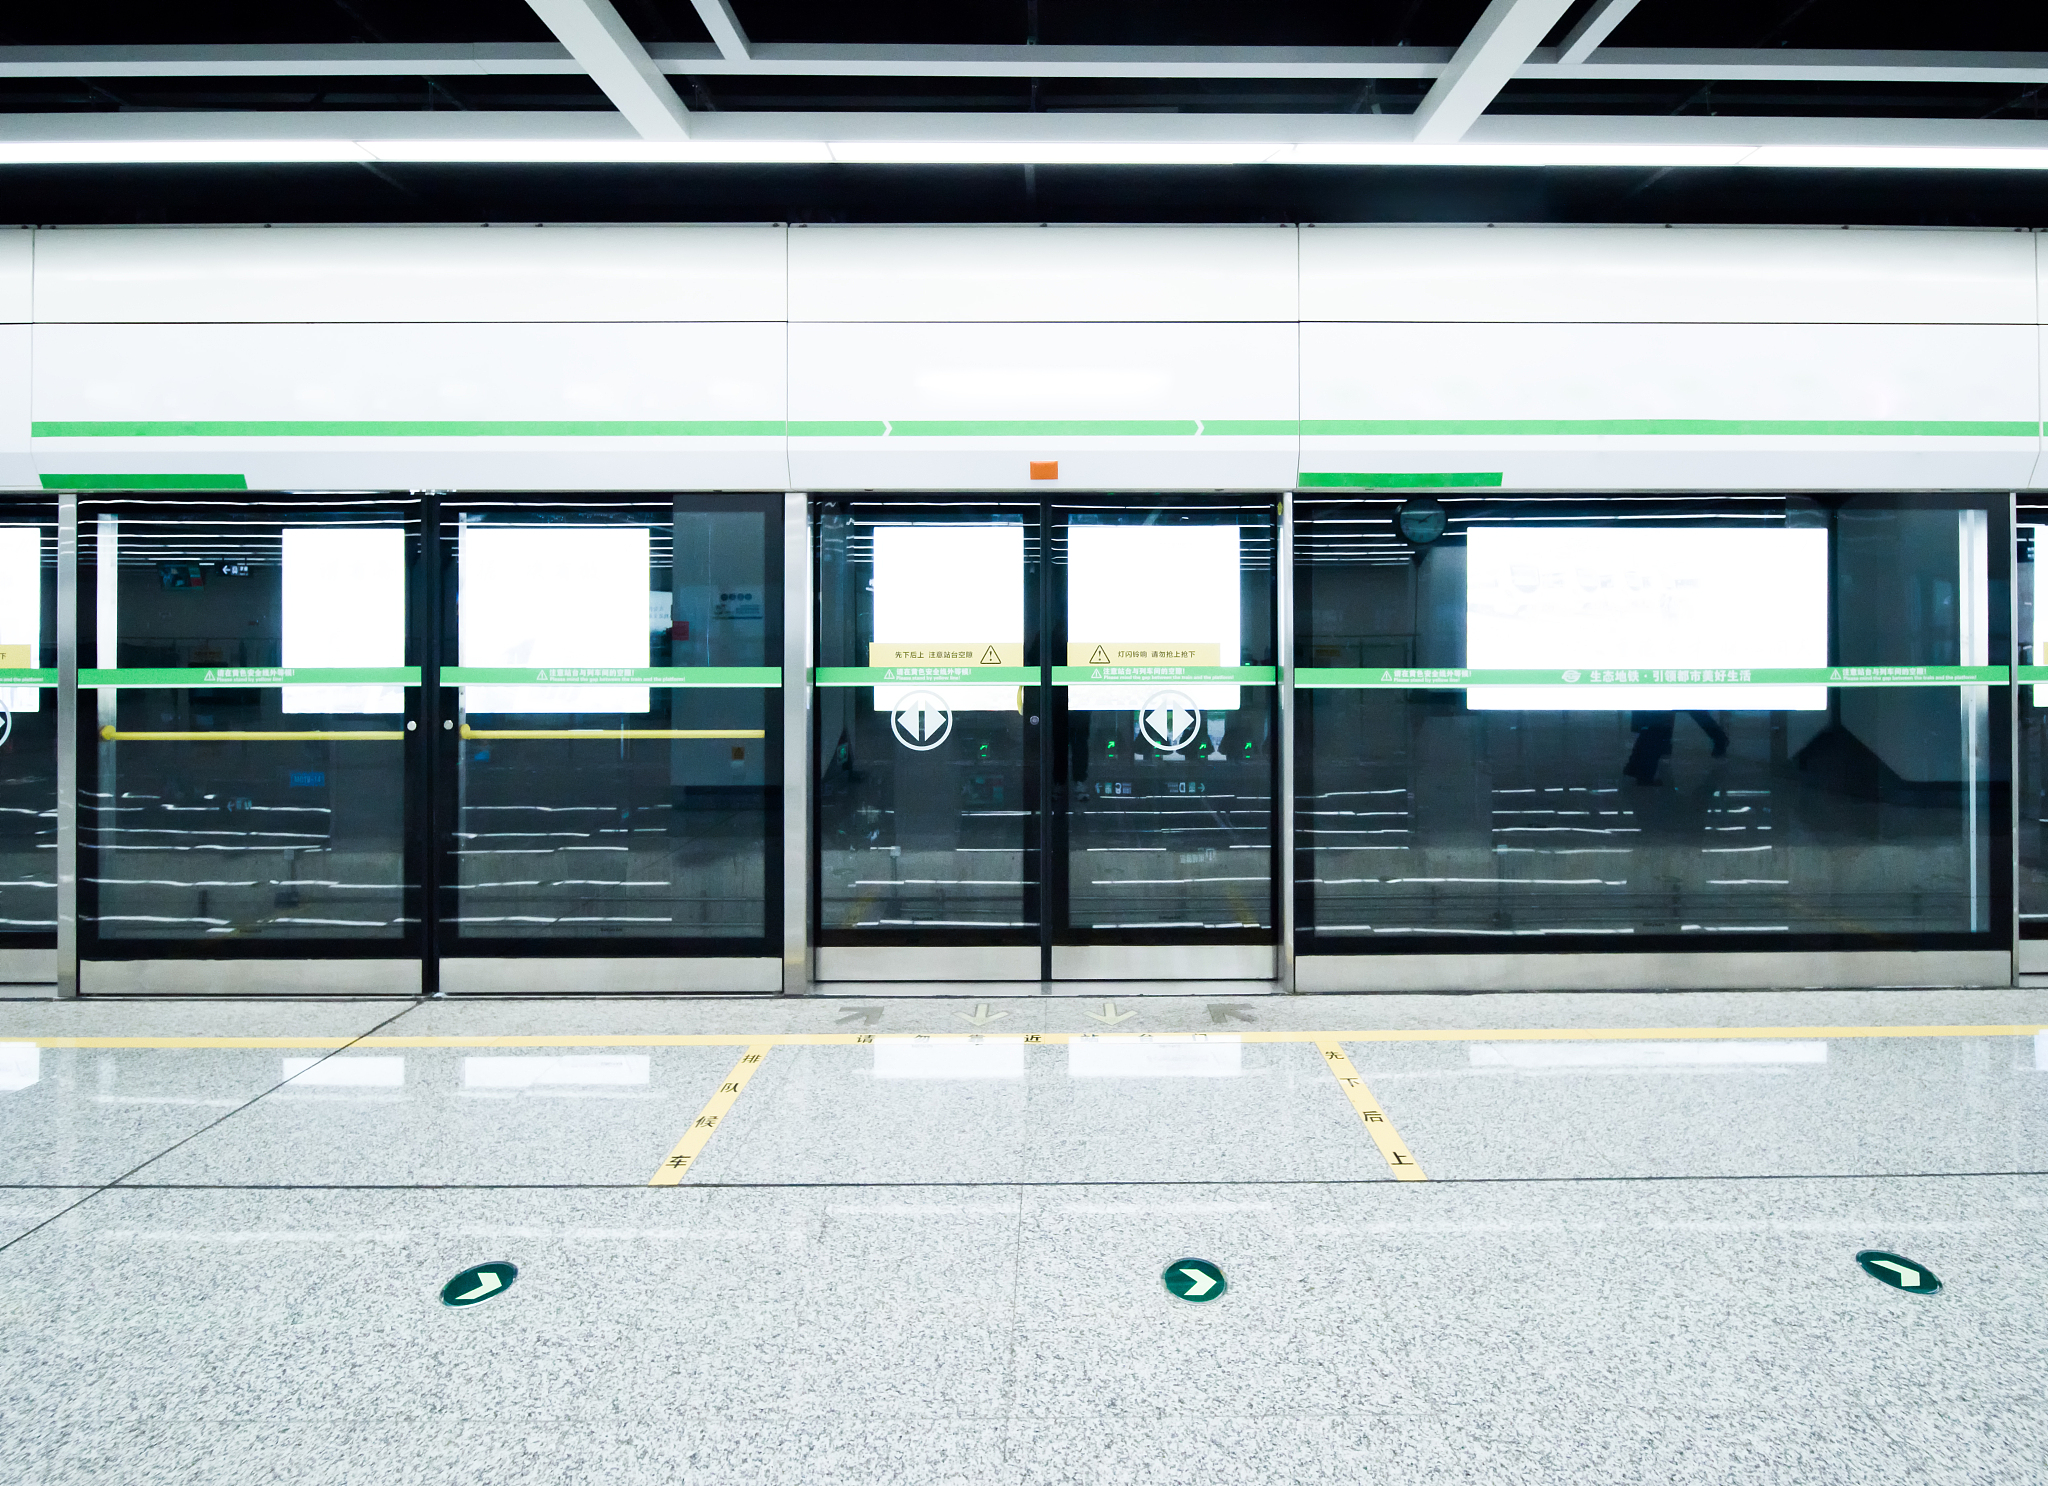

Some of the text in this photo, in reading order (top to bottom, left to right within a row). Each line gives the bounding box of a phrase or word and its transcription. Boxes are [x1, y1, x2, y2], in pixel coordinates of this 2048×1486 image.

[895, 651, 924, 659] 先下后上
[1118, 650, 1196, 658] 灯闪铃响 请勿抢上抢下
[665, 1054, 762, 1169] 排队候车
[1324, 1051, 1414, 1166] 先下后上
